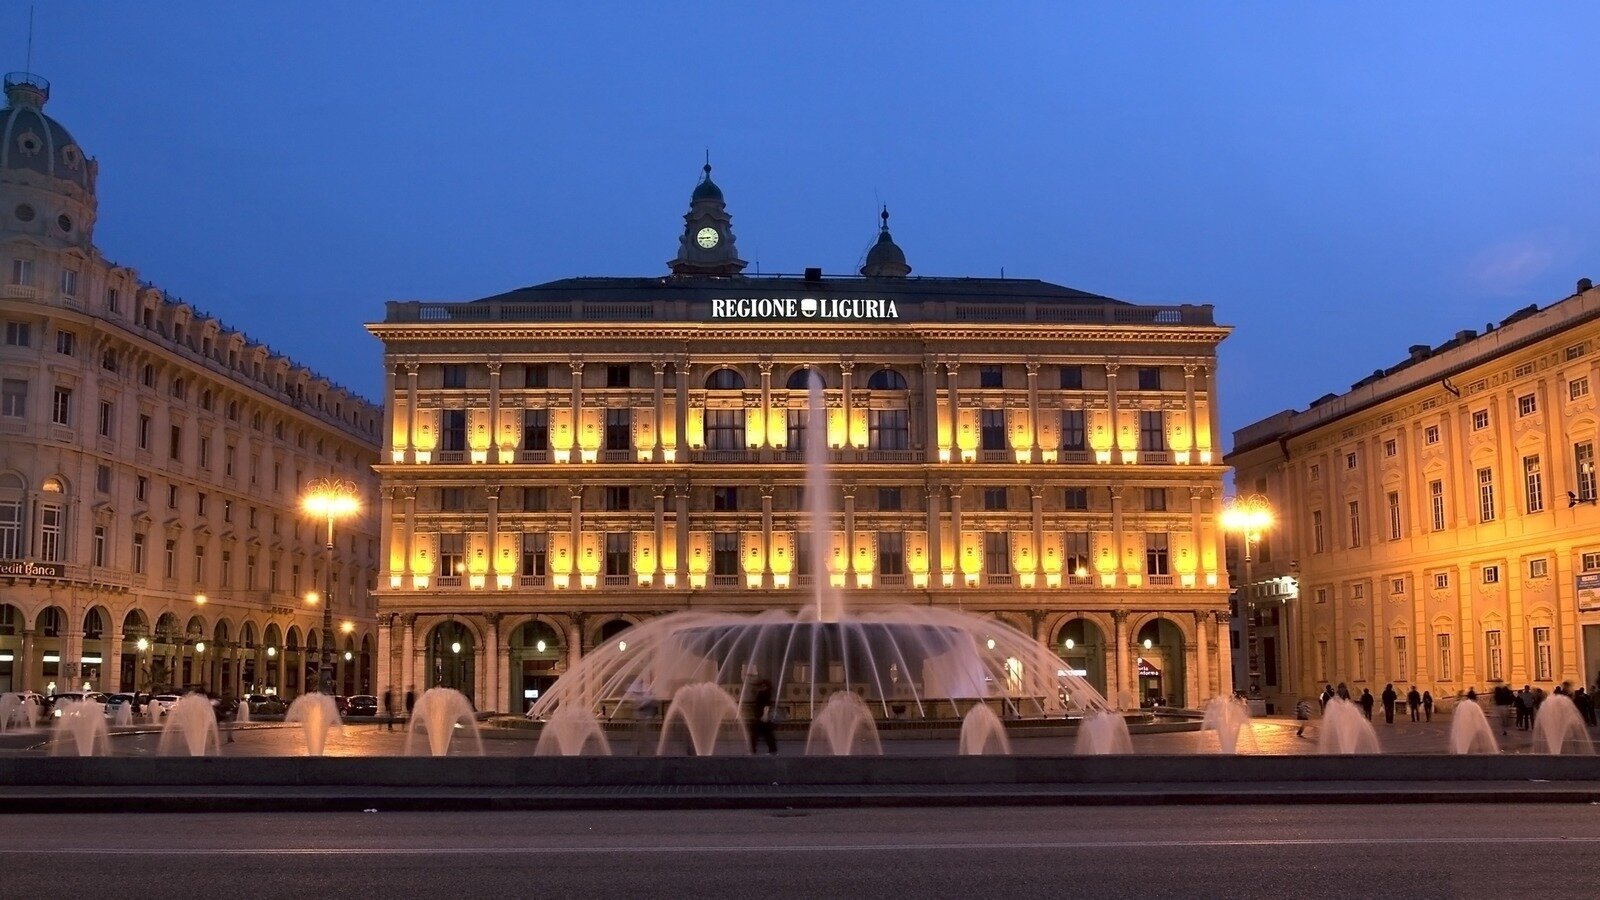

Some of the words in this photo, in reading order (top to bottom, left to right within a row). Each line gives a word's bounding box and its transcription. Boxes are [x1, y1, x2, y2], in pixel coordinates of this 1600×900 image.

[711, 299, 797, 318] REGIONE
[820, 299, 899, 318] LIGURIA
[25, 563, 56, 576] Banca
